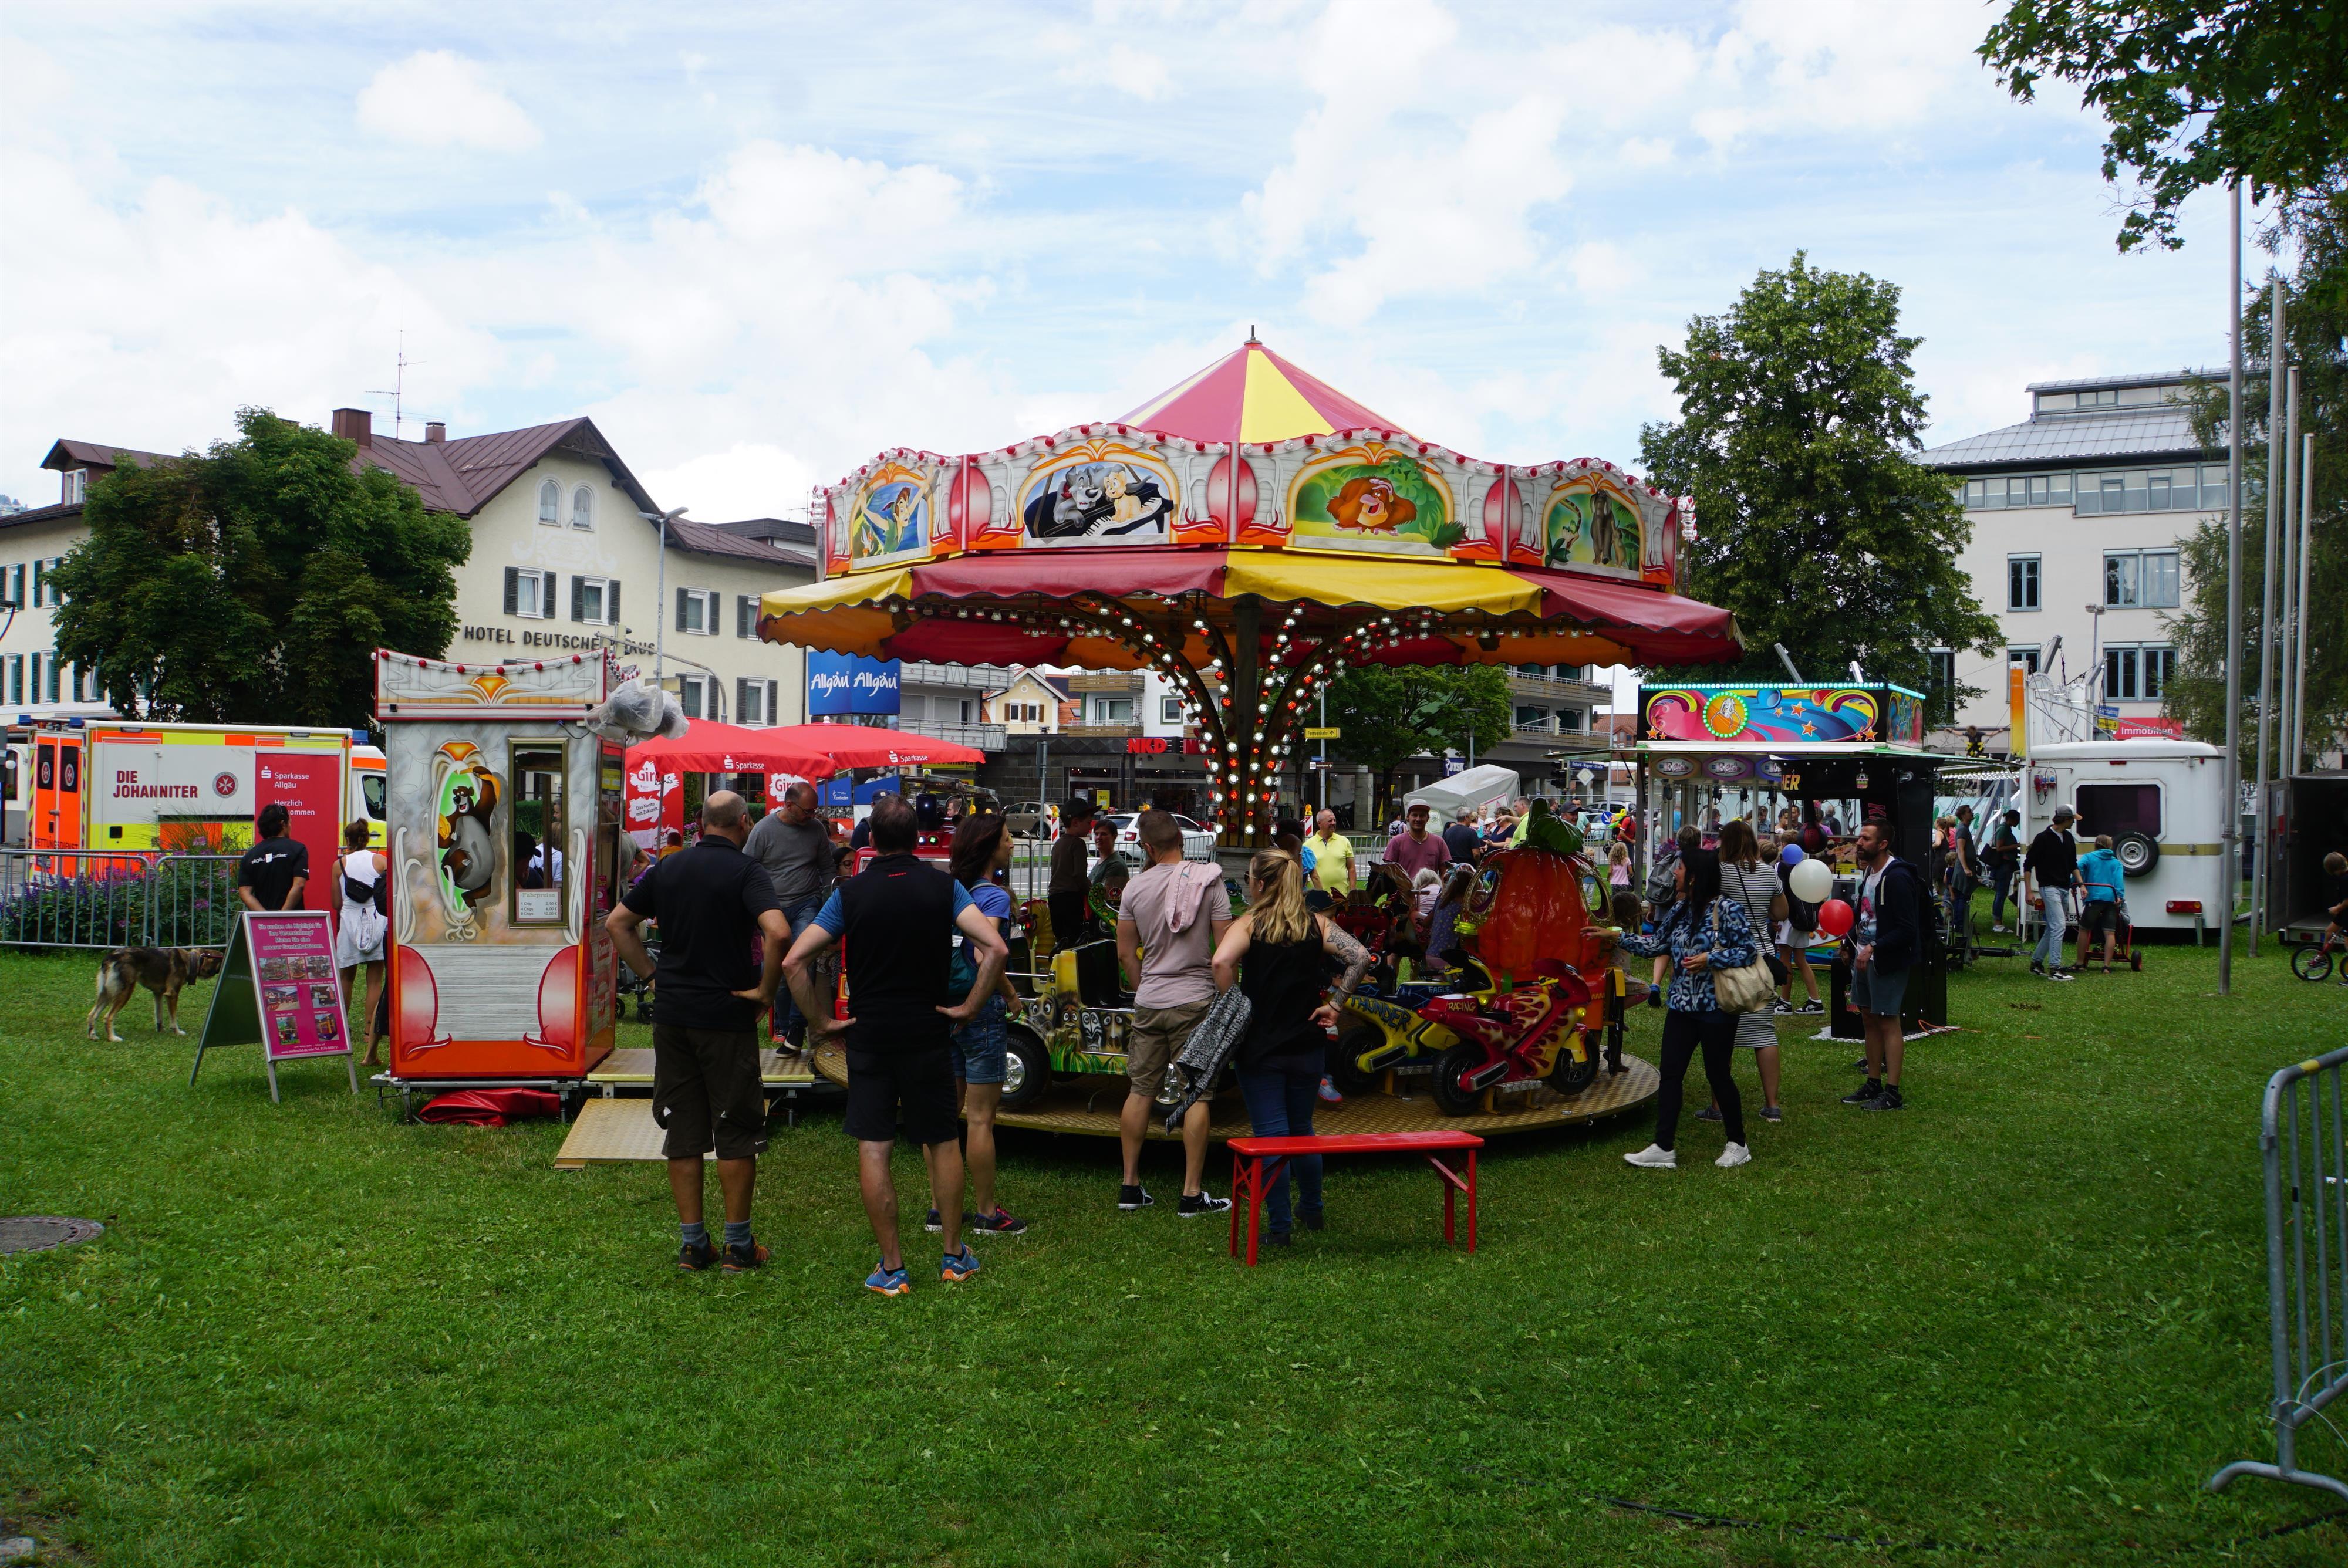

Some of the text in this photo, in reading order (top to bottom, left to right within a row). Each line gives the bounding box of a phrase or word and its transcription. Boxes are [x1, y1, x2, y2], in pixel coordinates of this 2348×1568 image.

[465, 626, 656, 655] HOTEL DEUTSCHE AUS
[811, 671, 898, 697] Allgäu Allgäu
[1128, 738, 1168, 753] NKD
[900, 755, 928, 763] Sparkasse
[736, 762, 765, 771] Sparkasse
[1449, 763, 1464, 772] JYSK
[117, 771, 137, 783] DIE
[274, 781, 296, 789] Allgäu
[775, 779, 794, 792] Gir
[113, 785, 198, 798] JOHANNITER
[1448, 1001, 1476, 1012] RACING
[1351, 996, 1411, 1032] THUNDER
